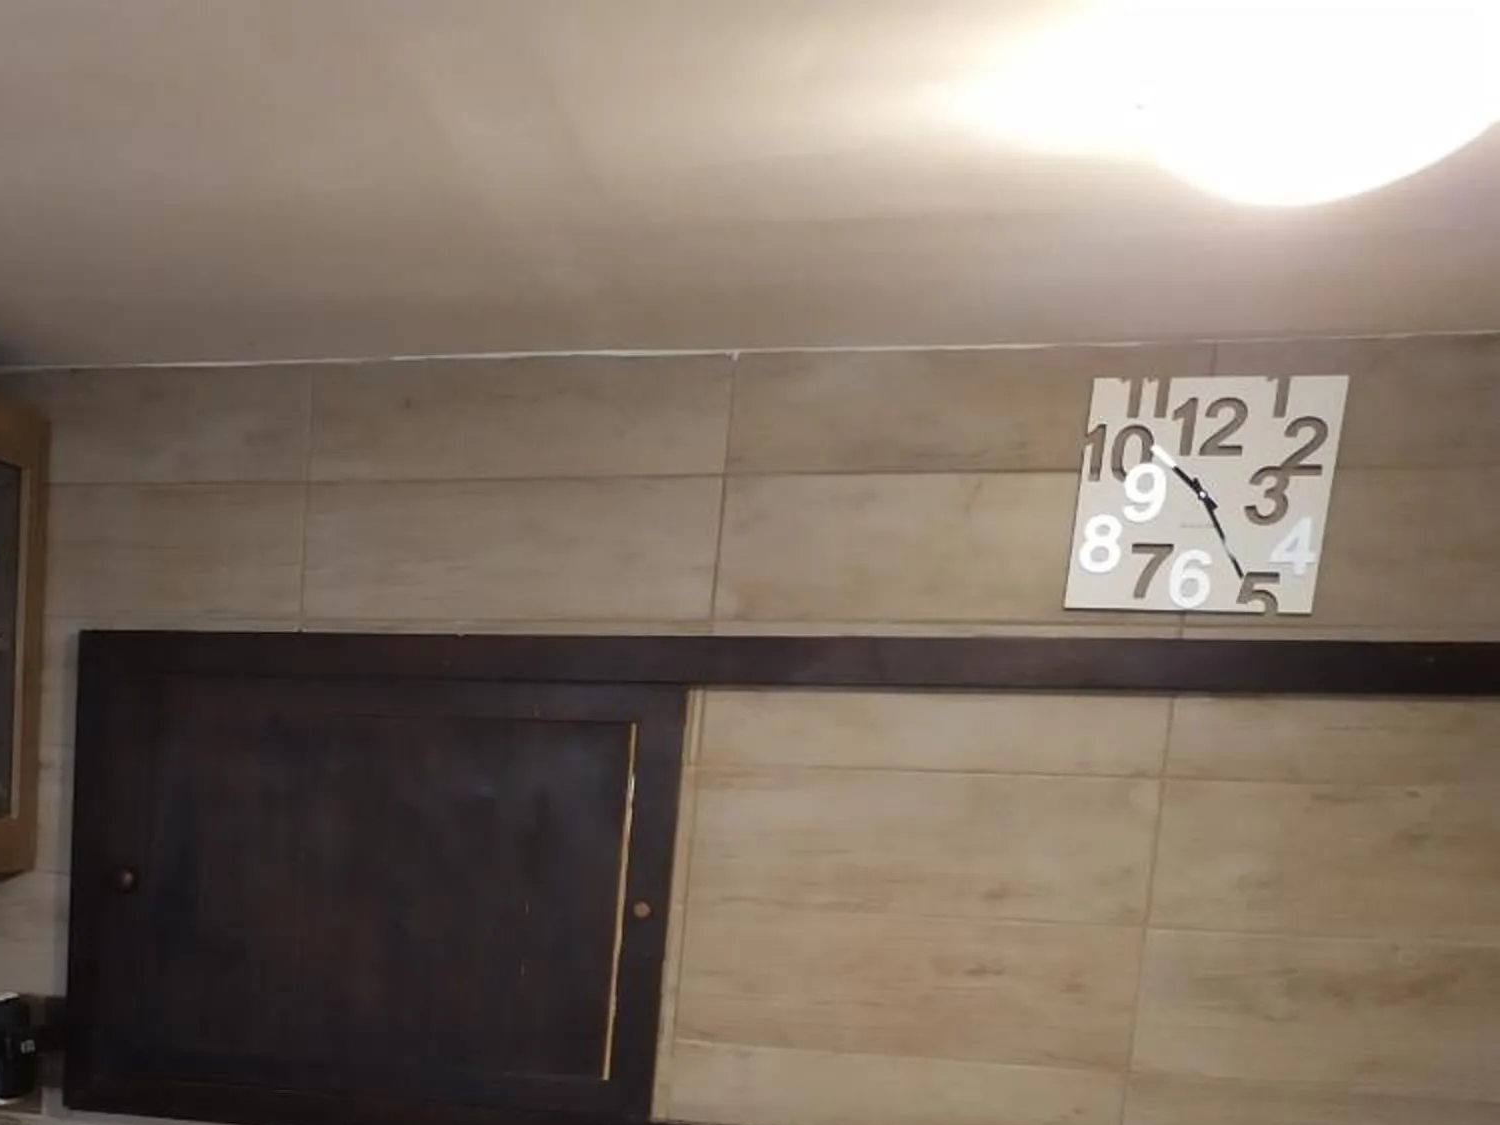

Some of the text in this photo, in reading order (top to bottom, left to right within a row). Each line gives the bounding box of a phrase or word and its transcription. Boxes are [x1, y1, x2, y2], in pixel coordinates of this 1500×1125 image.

[1119, 377, 1171, 419] 11
[1172, 396, 1249, 457] 12
[1266, 376, 1291, 419] 1
[1084, 422, 1155, 482] 10
[1278, 415, 1329, 477] 2
[1122, 462, 1167, 523] 9
[1244, 465, 1291, 526] 3
[1079, 514, 1123, 574] 8
[1131, 542, 1174, 600] 7
[1267, 516, 1318, 577] 4
[1168, 549, 1213, 610] 6
[1235, 571, 1281, 616] 5
